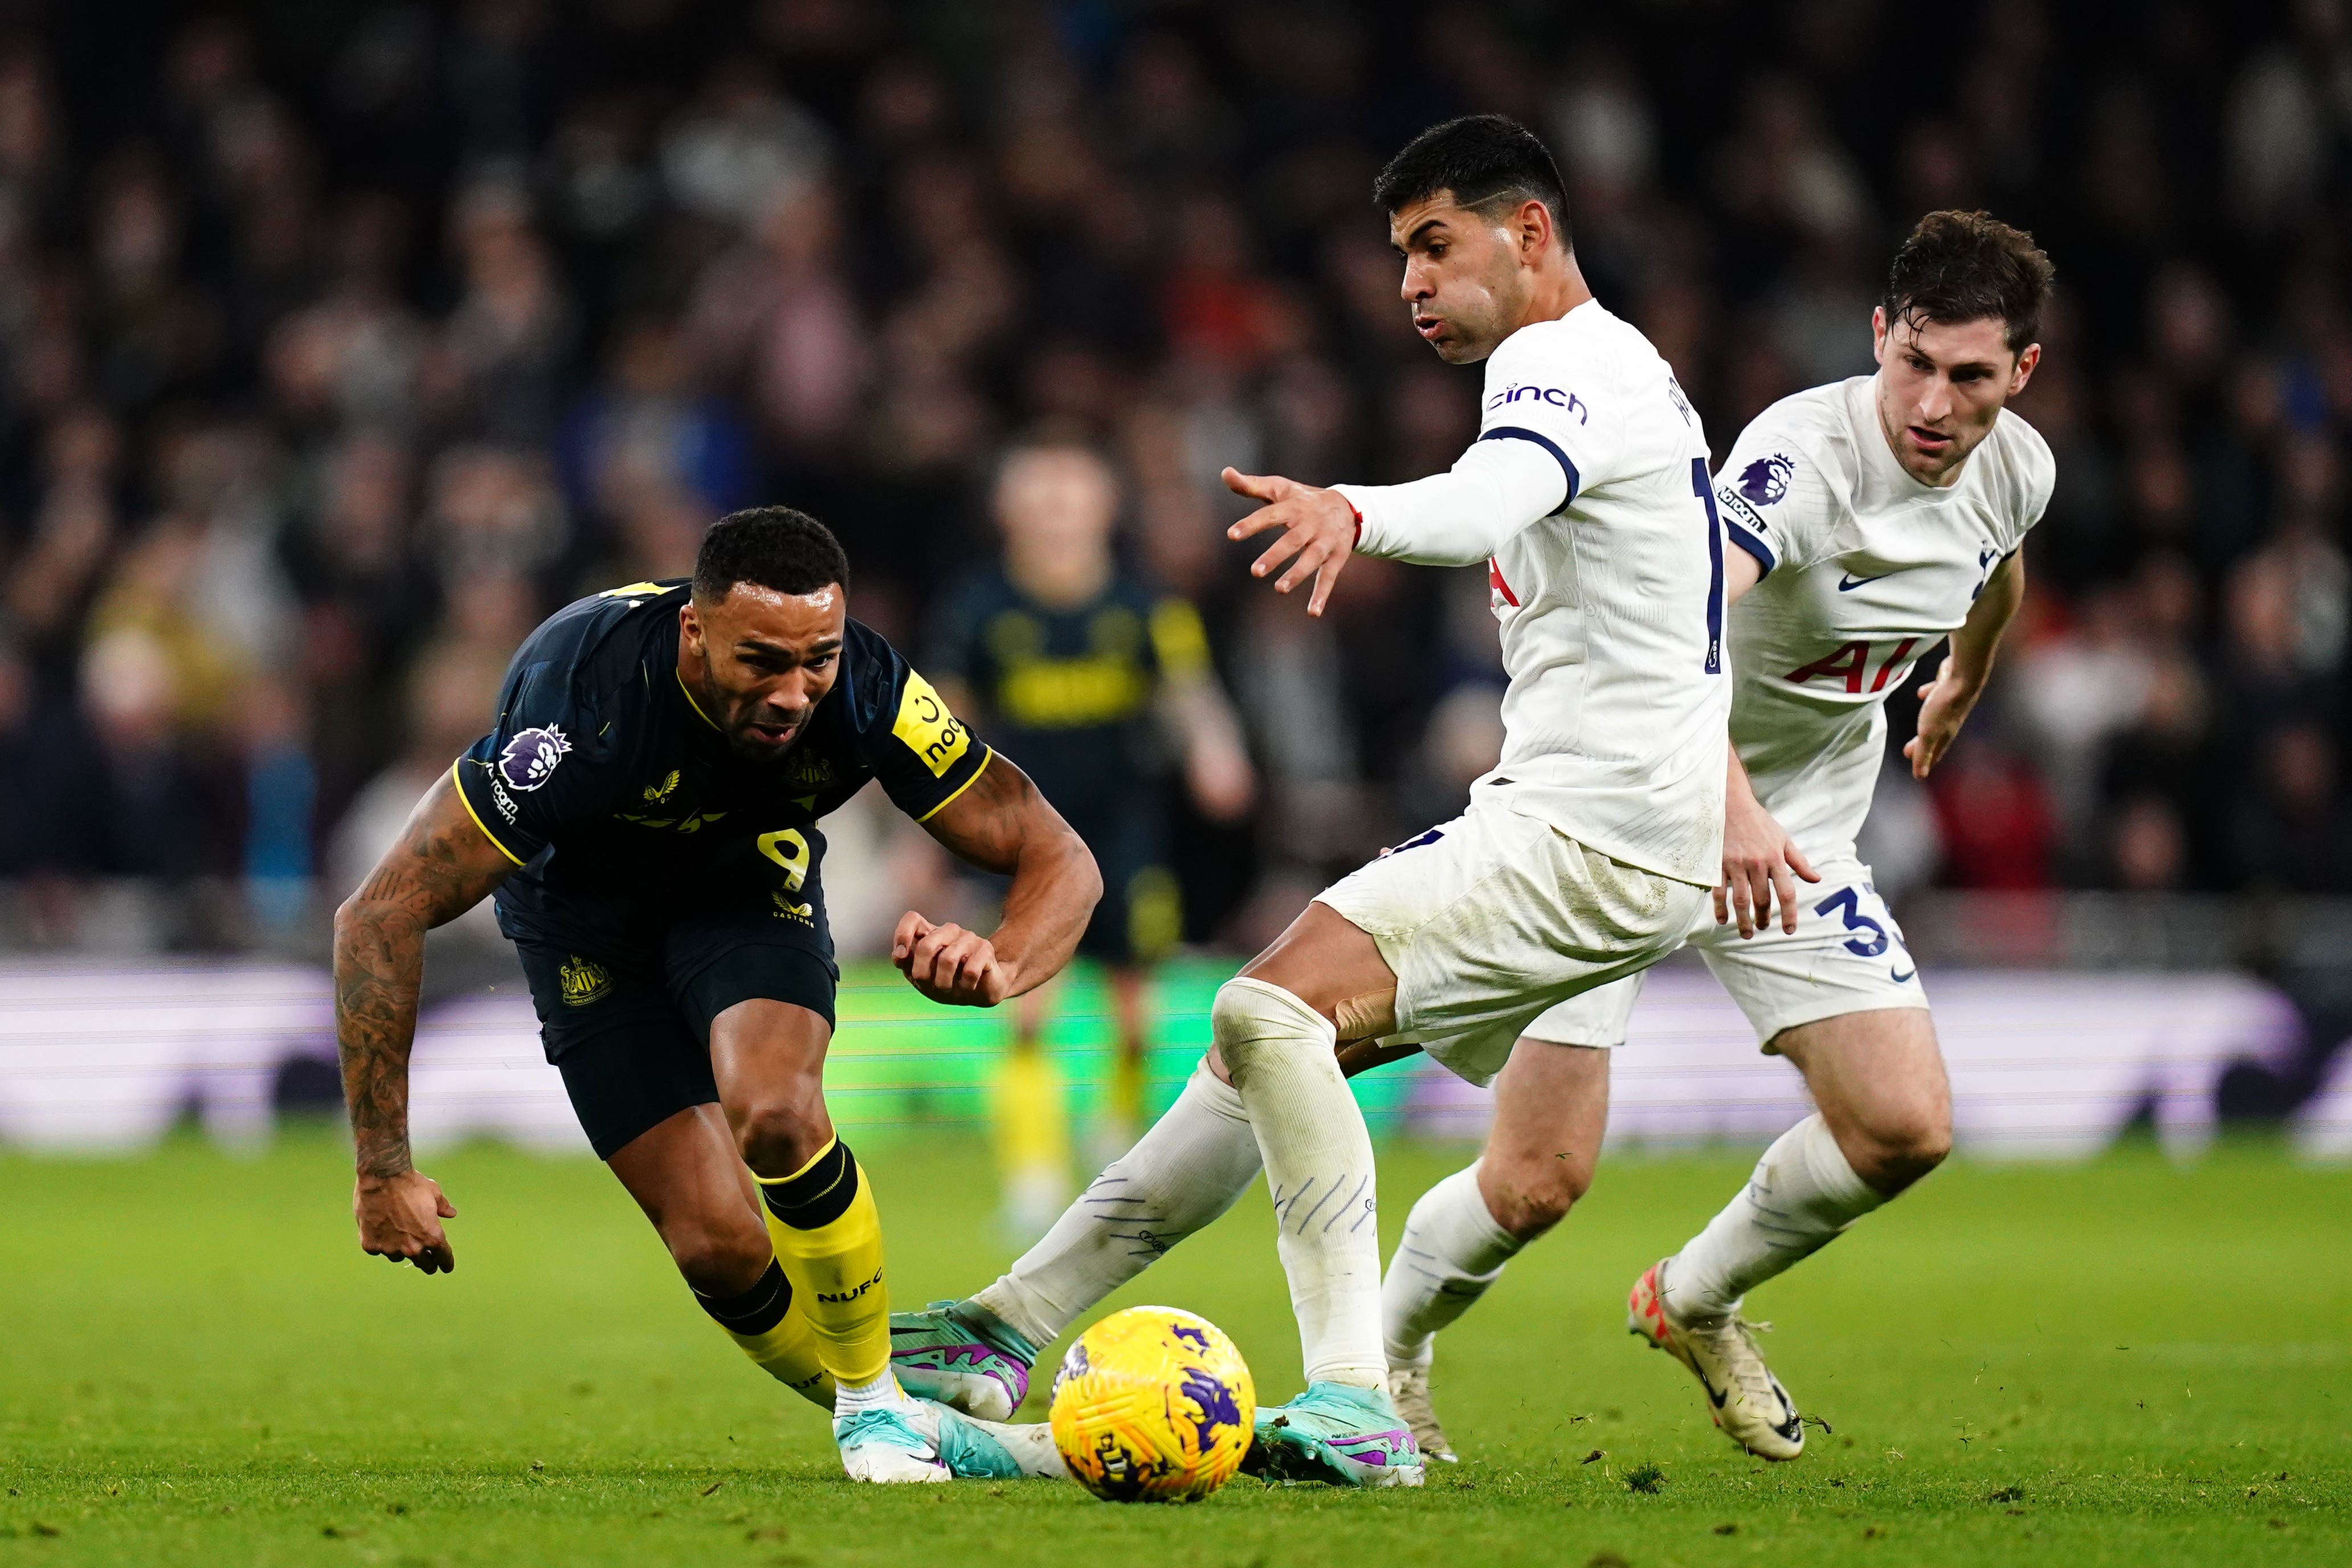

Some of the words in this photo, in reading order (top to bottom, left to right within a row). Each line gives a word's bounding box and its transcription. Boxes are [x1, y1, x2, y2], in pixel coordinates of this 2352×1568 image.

[1486, 383, 1588, 426] cinch
[1716, 485, 1734, 503] No
[1729, 497, 1761, 530] room
[1783, 636, 1919, 693] AI
[491, 778, 518, 814] room
[757, 828, 810, 893] 9
[773, 911, 815, 929] CASTORE
[1813, 882, 1908, 957] 3
